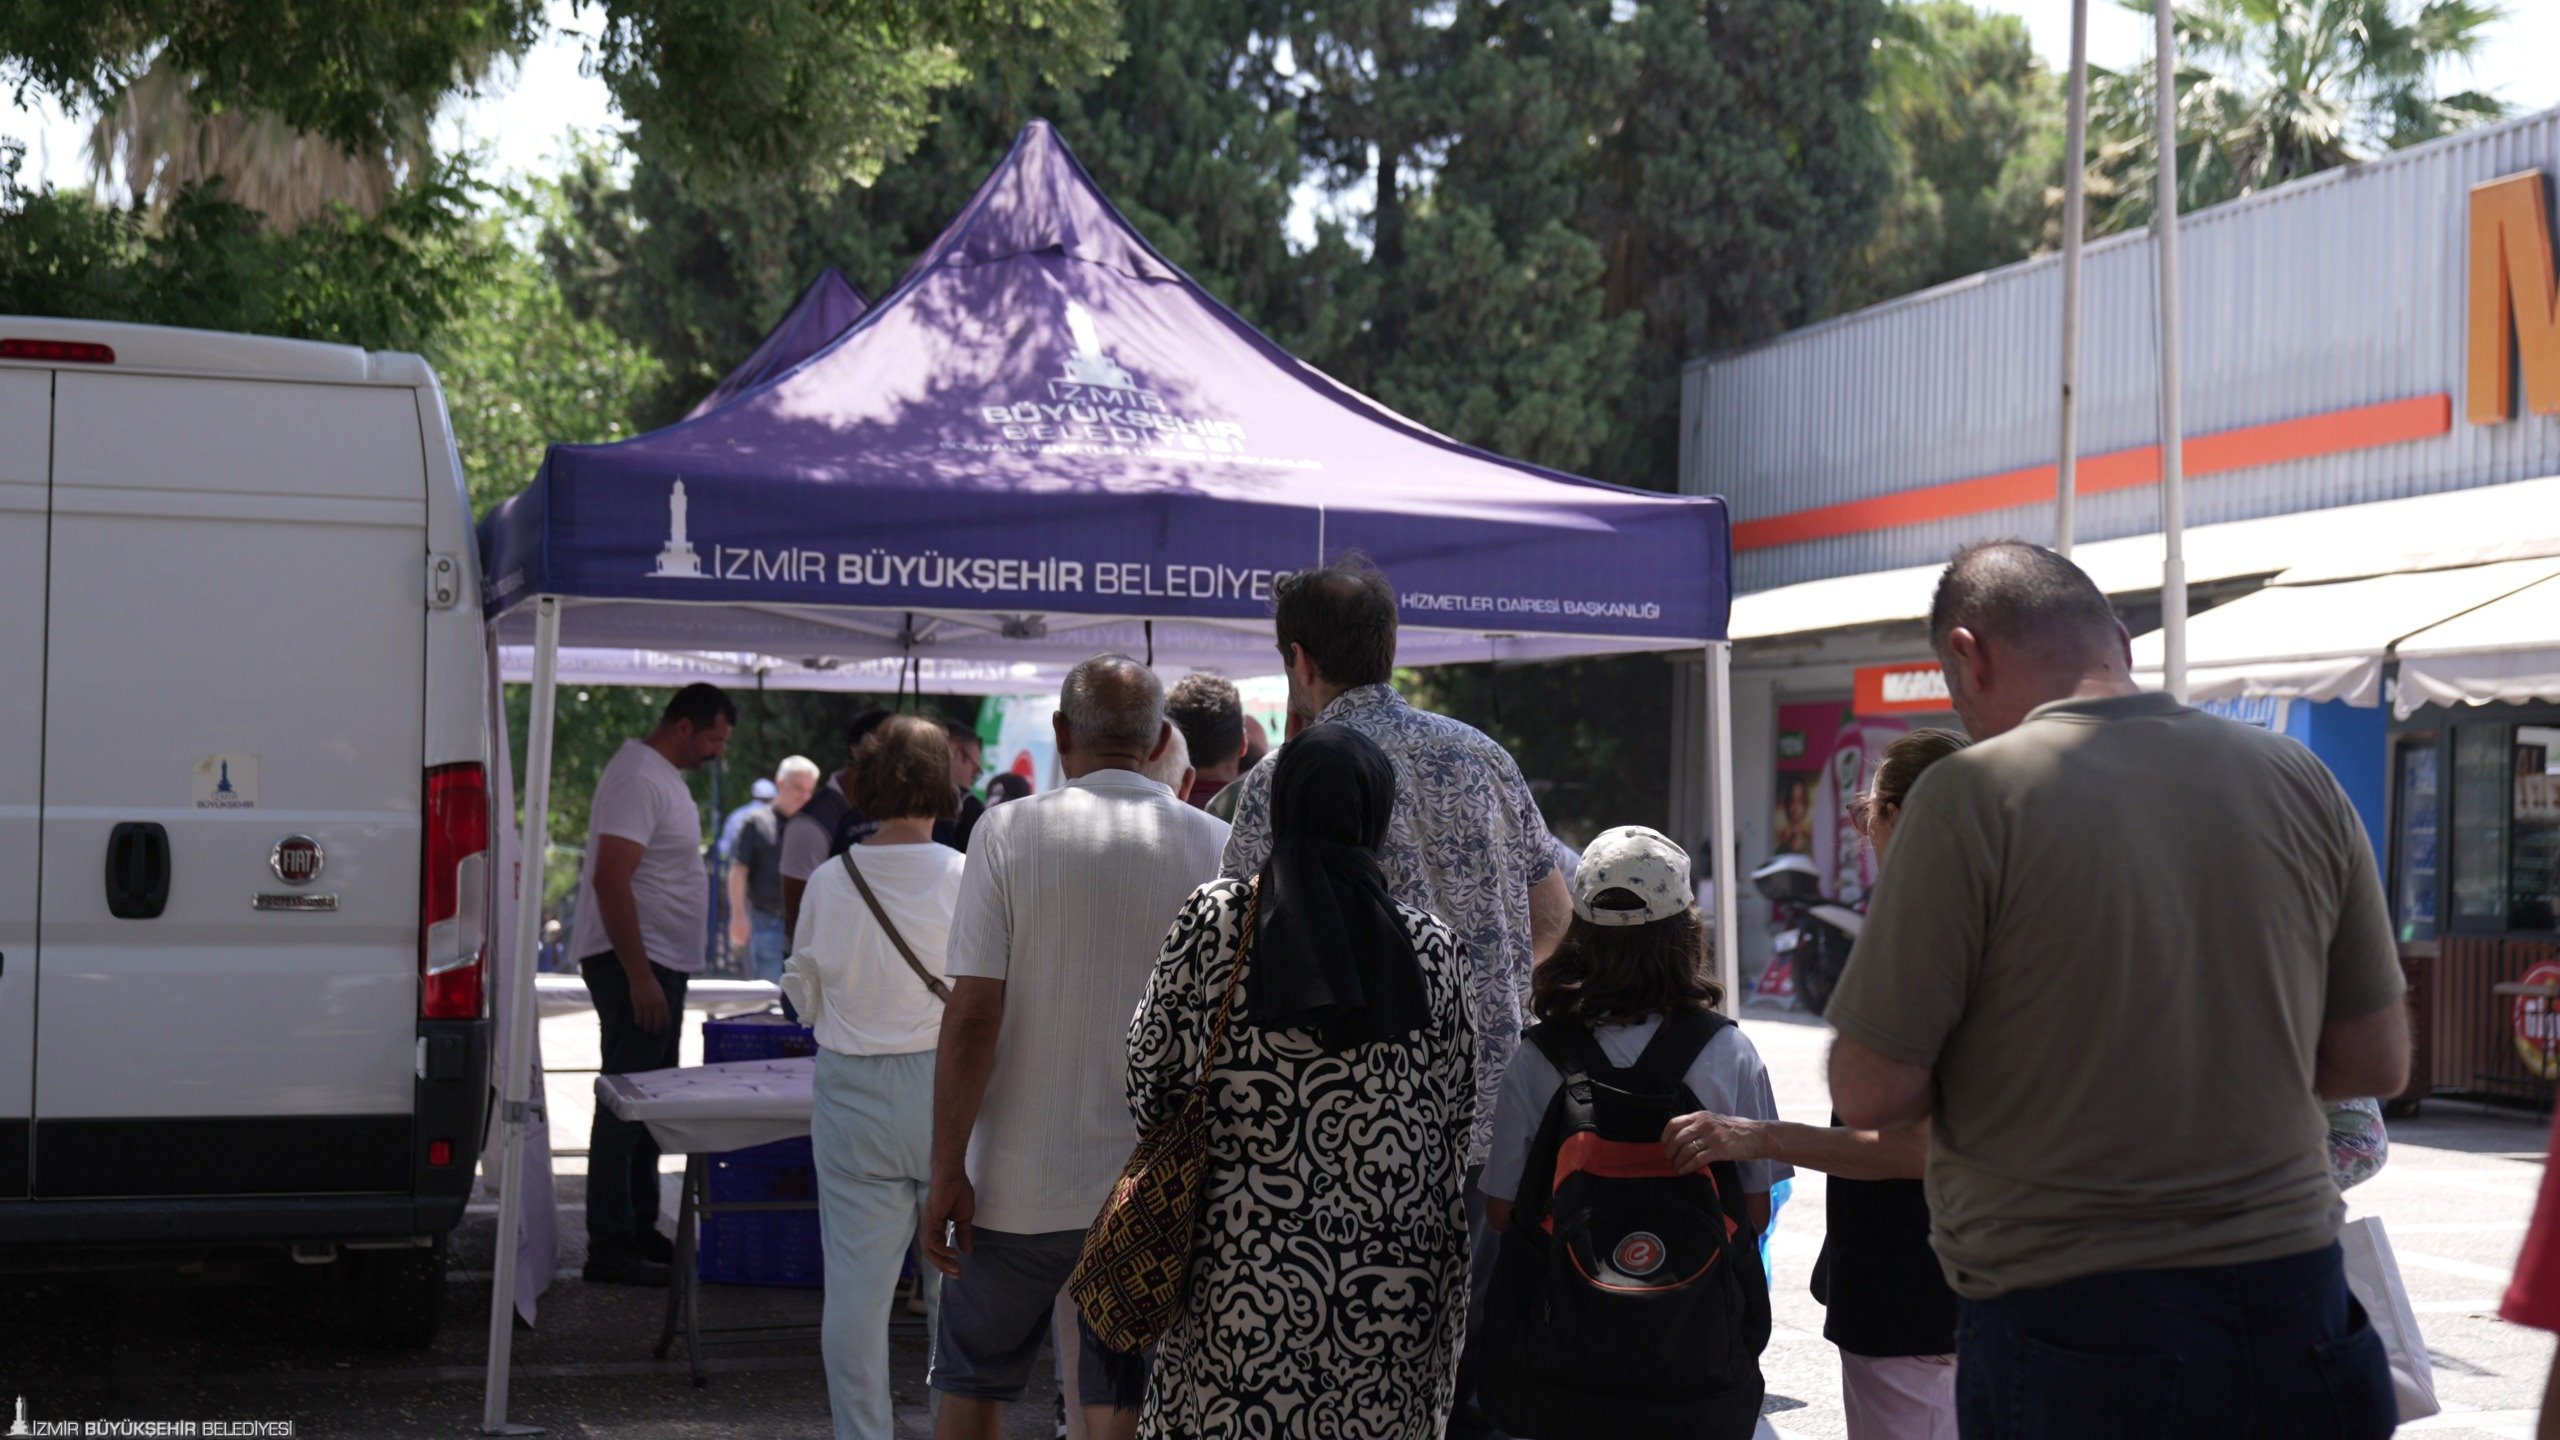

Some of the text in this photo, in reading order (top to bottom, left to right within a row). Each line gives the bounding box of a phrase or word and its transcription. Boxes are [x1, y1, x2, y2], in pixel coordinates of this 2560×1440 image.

[714, 544, 1301, 600] İZMİR BÜYÜKŞEHİR BELEDİYE
[1401, 591, 1660, 620] HİZMETLER DAİRESİ BAŞKANLIĞI
[284, 850, 313, 872] FIAT
